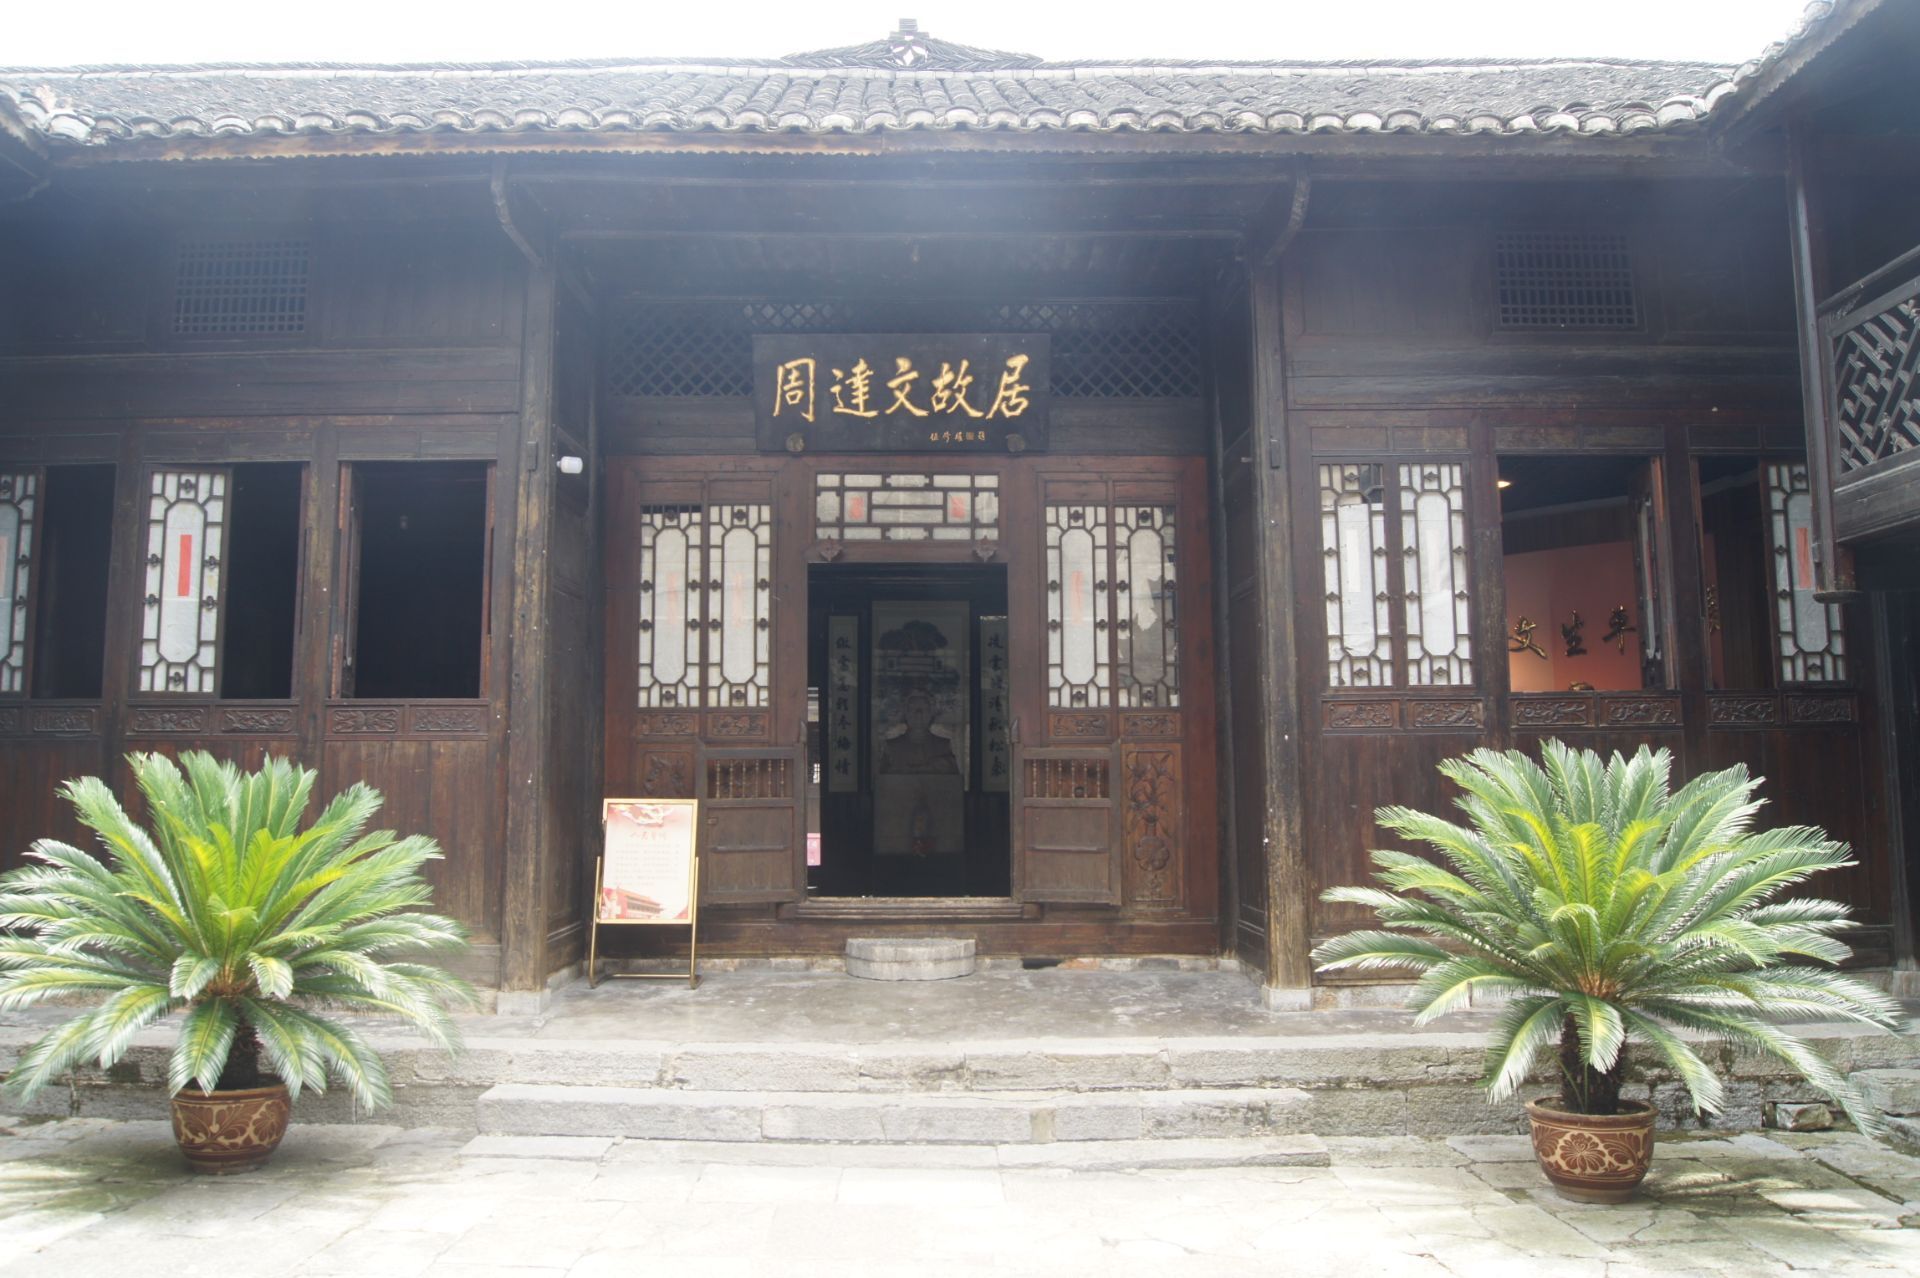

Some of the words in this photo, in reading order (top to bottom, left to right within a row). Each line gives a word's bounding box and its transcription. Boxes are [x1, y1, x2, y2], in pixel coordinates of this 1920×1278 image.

[772, 353, 1031, 422] 周達文故居
